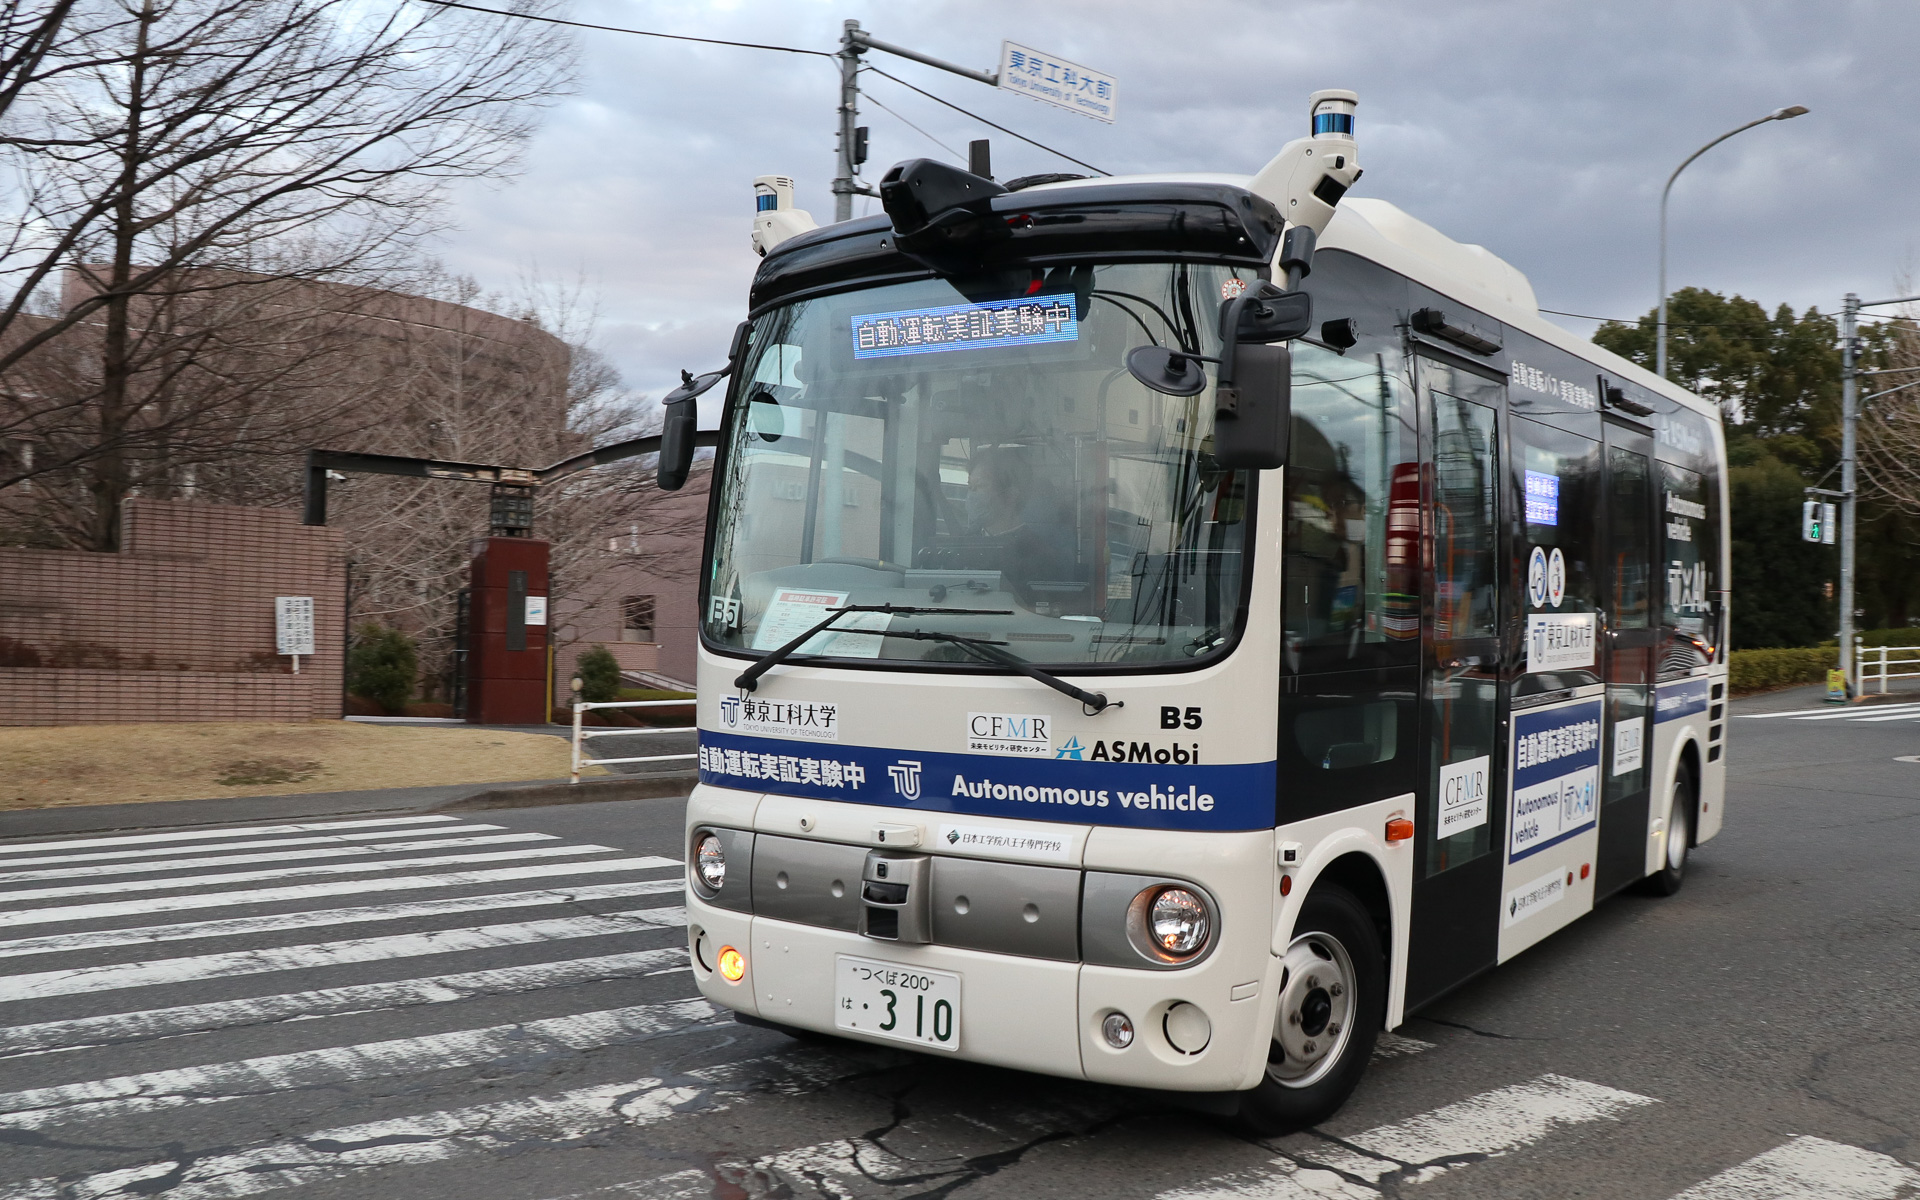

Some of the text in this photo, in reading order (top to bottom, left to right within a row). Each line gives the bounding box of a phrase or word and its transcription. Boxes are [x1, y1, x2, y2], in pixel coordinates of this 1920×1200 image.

[1009, 50, 1112, 100] 東京工科大前
[857, 301, 1071, 349] 自動運転実証実験中
[713, 599, 736, 624] B5
[1547, 622, 1592, 650] 東京工科大学
[743, 699, 836, 728] 東京工科大学
[1160, 706, 1203, 730] B5
[743, 724, 760, 732] TOKYO
[760, 726, 790, 735] UNIVERSITY
[799, 729, 836, 739] TECHNOLOGY
[971, 715, 1049, 739] CFMR
[970, 742, 1047, 753] 未来モビリティ研究センター
[1090, 740, 1199, 765] ASMobi
[1517, 719, 1599, 770] 自動運転実証実験中
[699, 744, 866, 790] 自動運転実証実験中
[951, 774, 1215, 811] Autonomous vehicle
[1445, 771, 1484, 806] CFMR
[1516, 792, 1559, 818] Autonomous
[963, 833, 1061, 851] 日本工学院八王子専門学校
[1515, 818, 1539, 845] vehicle
[841, 997, 853, 1010] は
